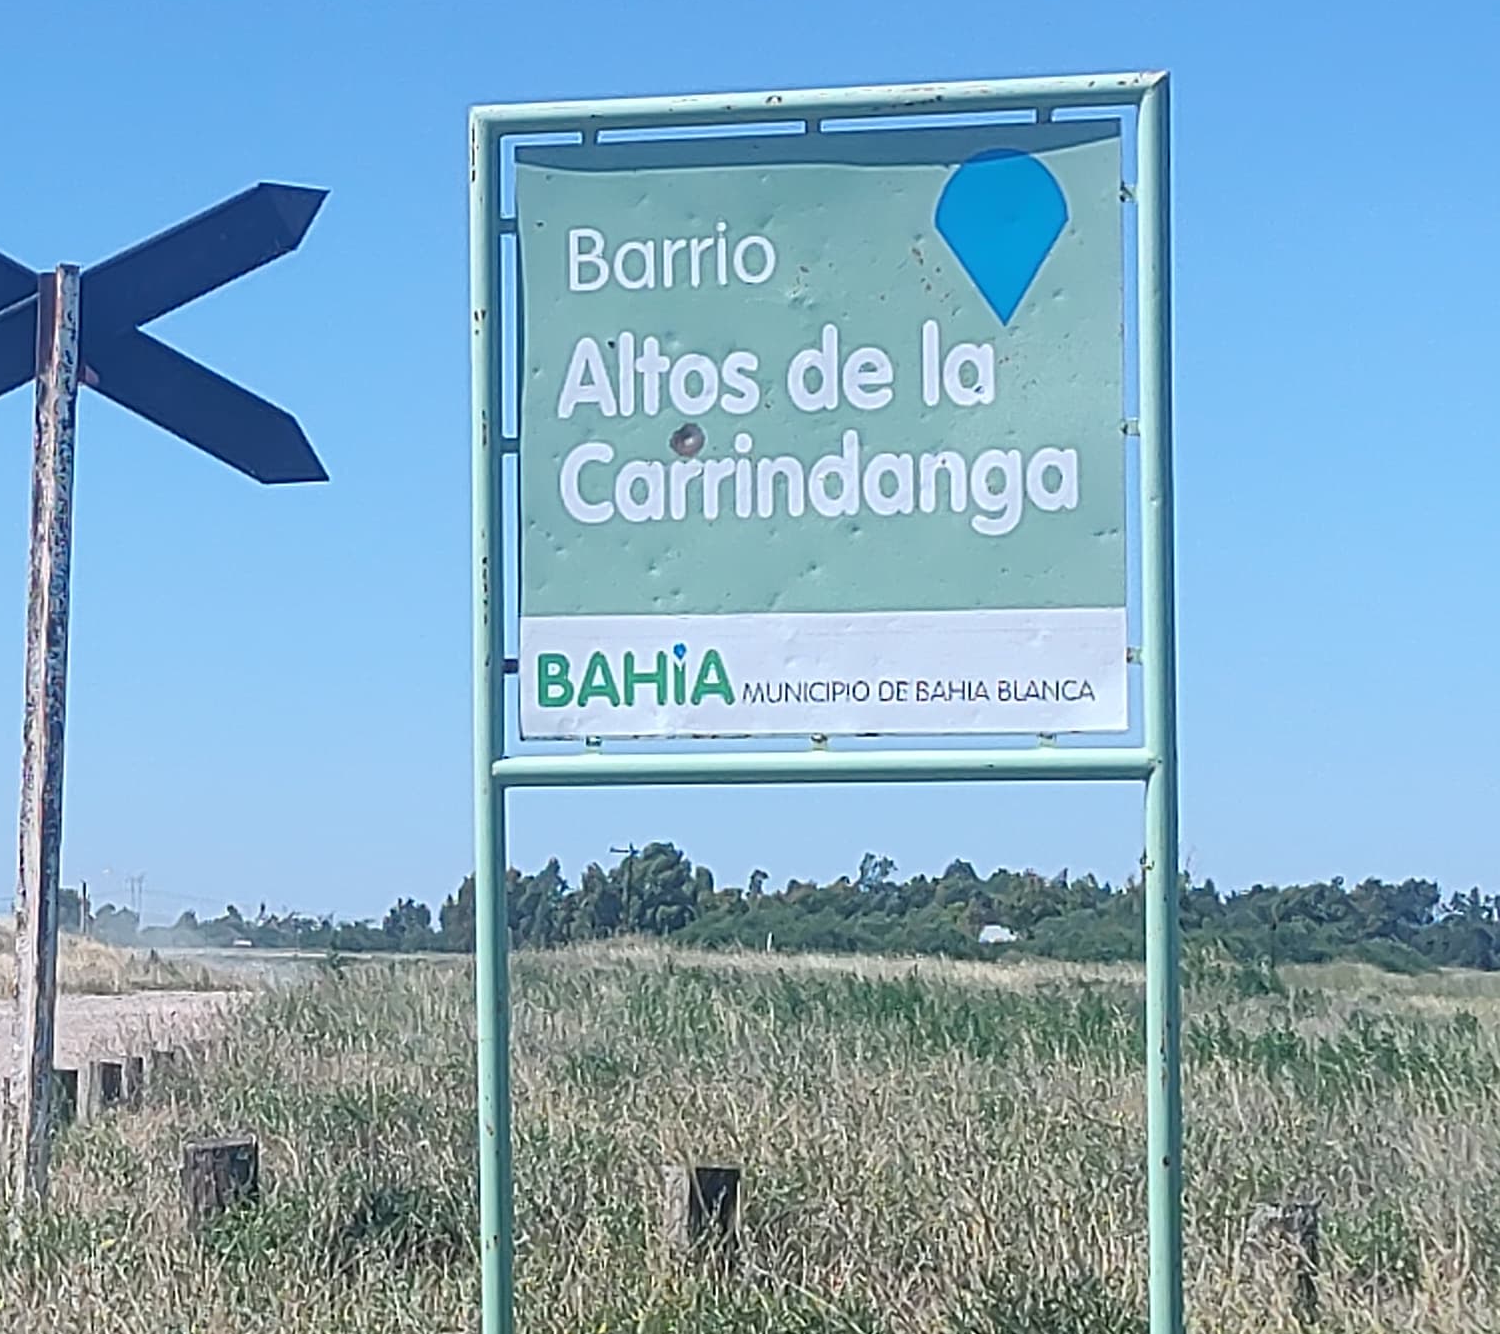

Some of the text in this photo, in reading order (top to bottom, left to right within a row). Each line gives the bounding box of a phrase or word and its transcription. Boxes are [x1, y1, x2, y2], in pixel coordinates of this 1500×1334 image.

[567, 221, 776, 293] Barrio
[557, 319, 996, 420] Altos de la
[559, 430, 1079, 535] Carrindanga
[742, 680, 1096, 704] MUNICIPIO DE BAHIA BLANCA
